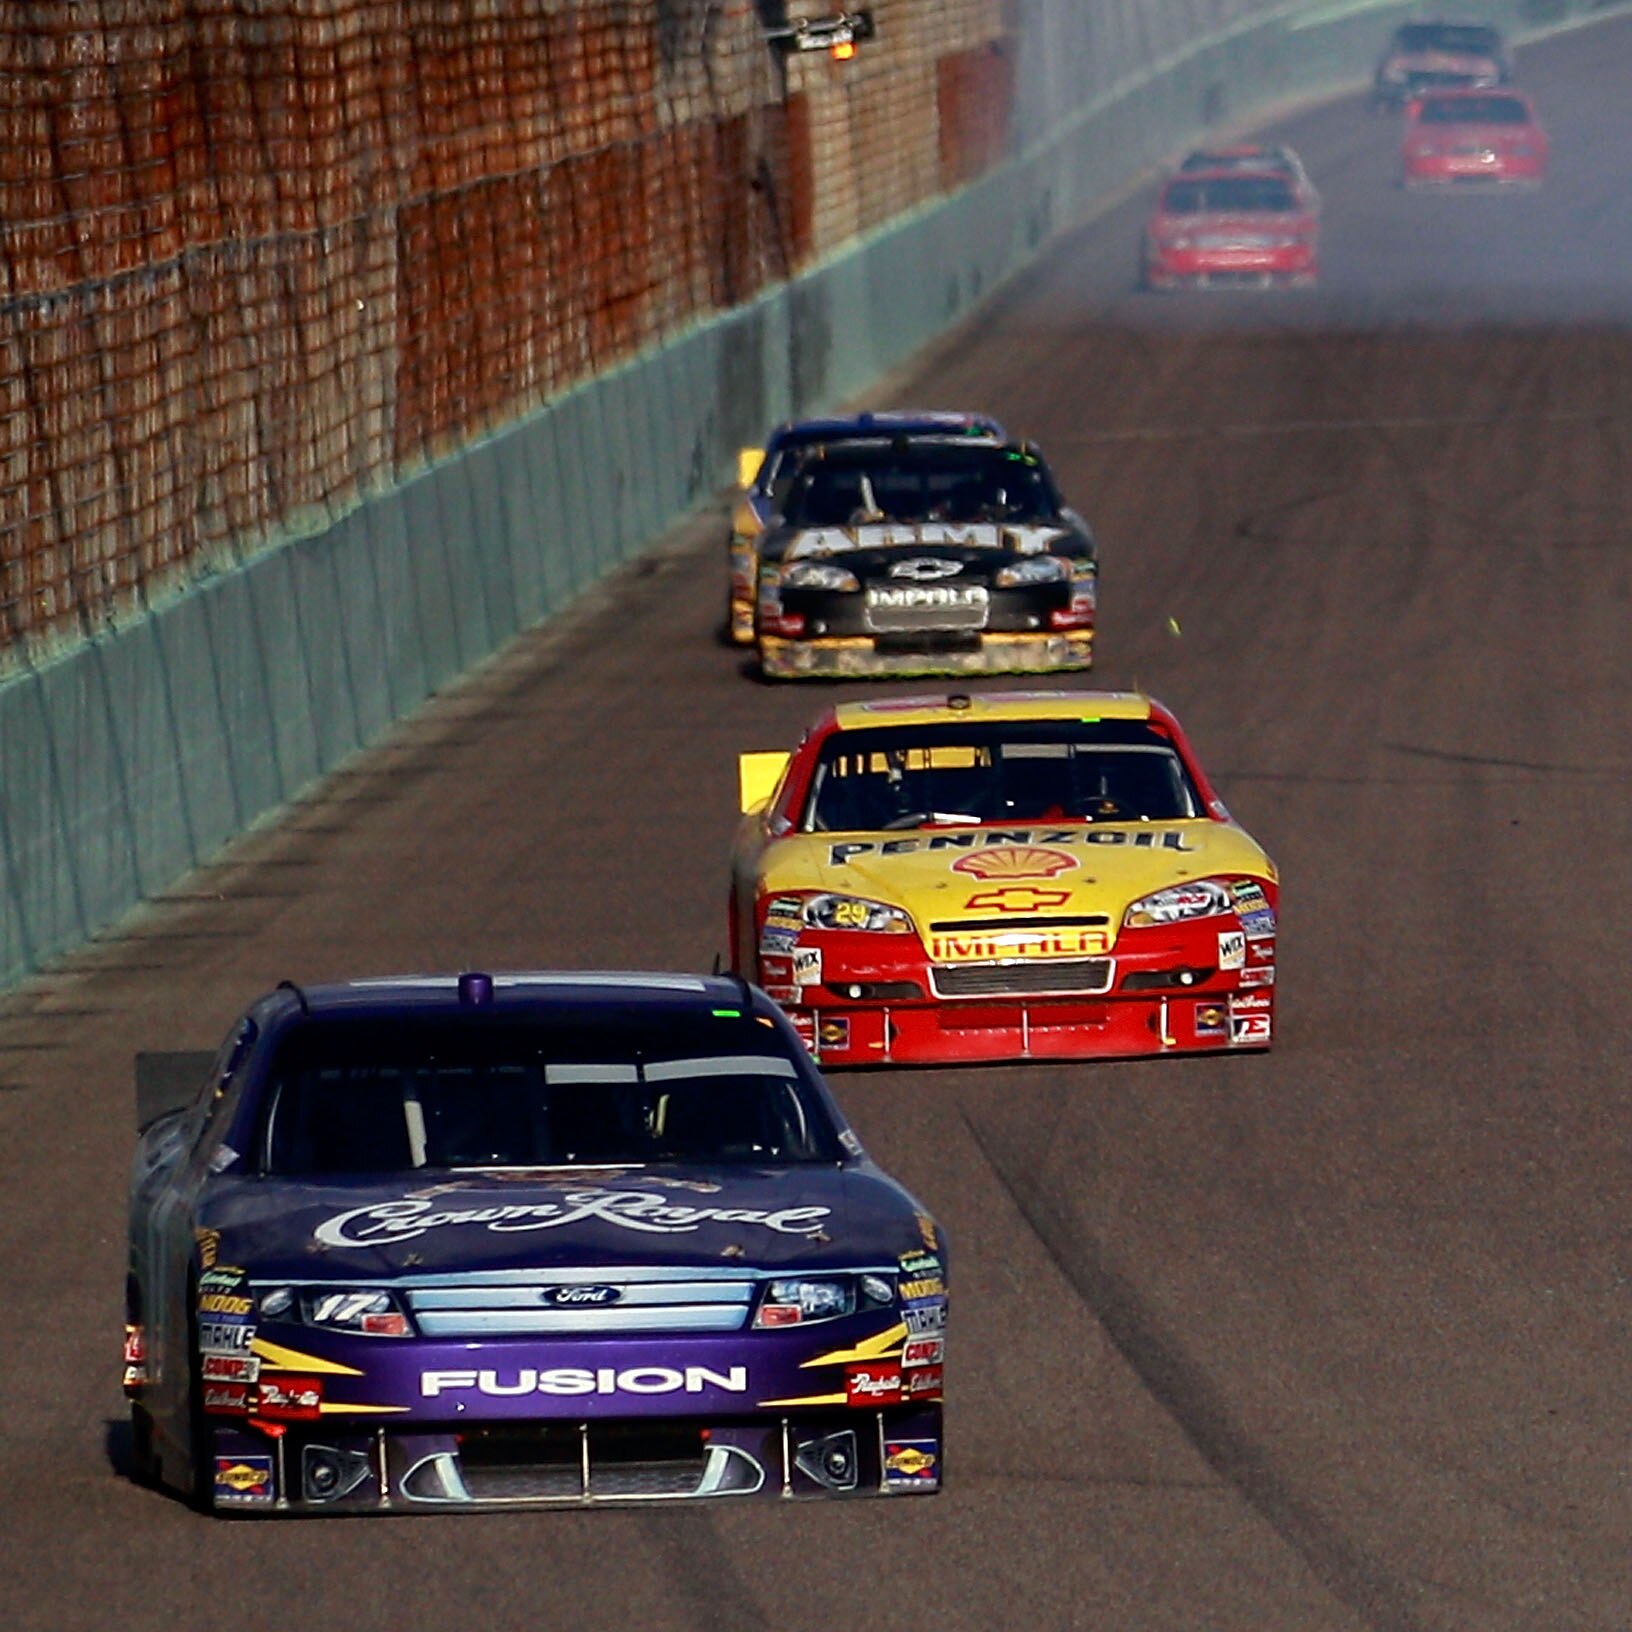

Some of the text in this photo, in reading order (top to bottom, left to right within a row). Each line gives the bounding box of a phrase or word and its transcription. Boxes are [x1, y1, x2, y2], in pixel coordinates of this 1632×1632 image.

[830, 831, 1195, 866] PENNZOIL
[835, 901, 867, 924] 29
[314, 1190, 832, 1247] Crown Royal
[314, 1294, 371, 1321] 17
[555, 1286, 607, 1303] Ford
[421, 1366, 747, 1397] FUSION
